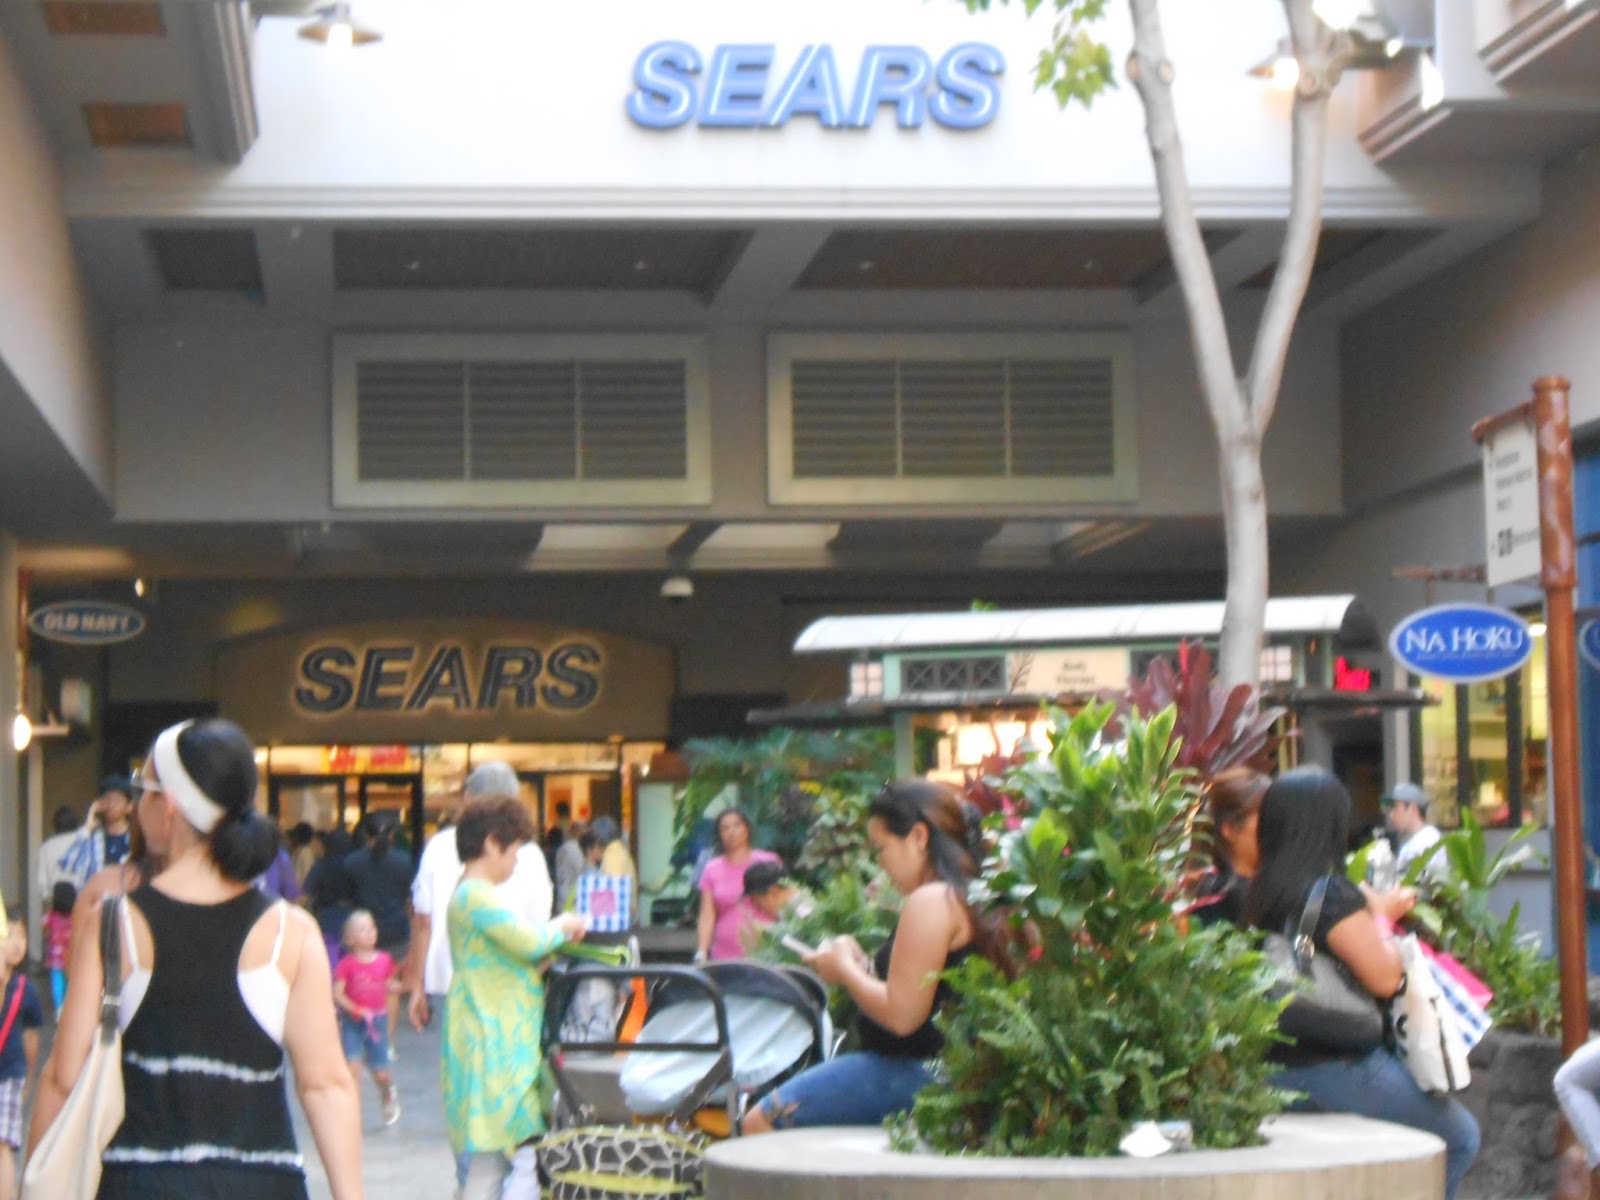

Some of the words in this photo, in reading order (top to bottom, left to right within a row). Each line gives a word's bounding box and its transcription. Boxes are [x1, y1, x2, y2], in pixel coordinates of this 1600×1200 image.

[625, 39, 1006, 130] SEARS
[43, 613, 79, 631] OLD
[81, 613, 130, 632] NAVY
[1406, 628, 1446, 653] NA
[1452, 625, 1524, 652] HOKU
[295, 643, 601, 712] SEARS
